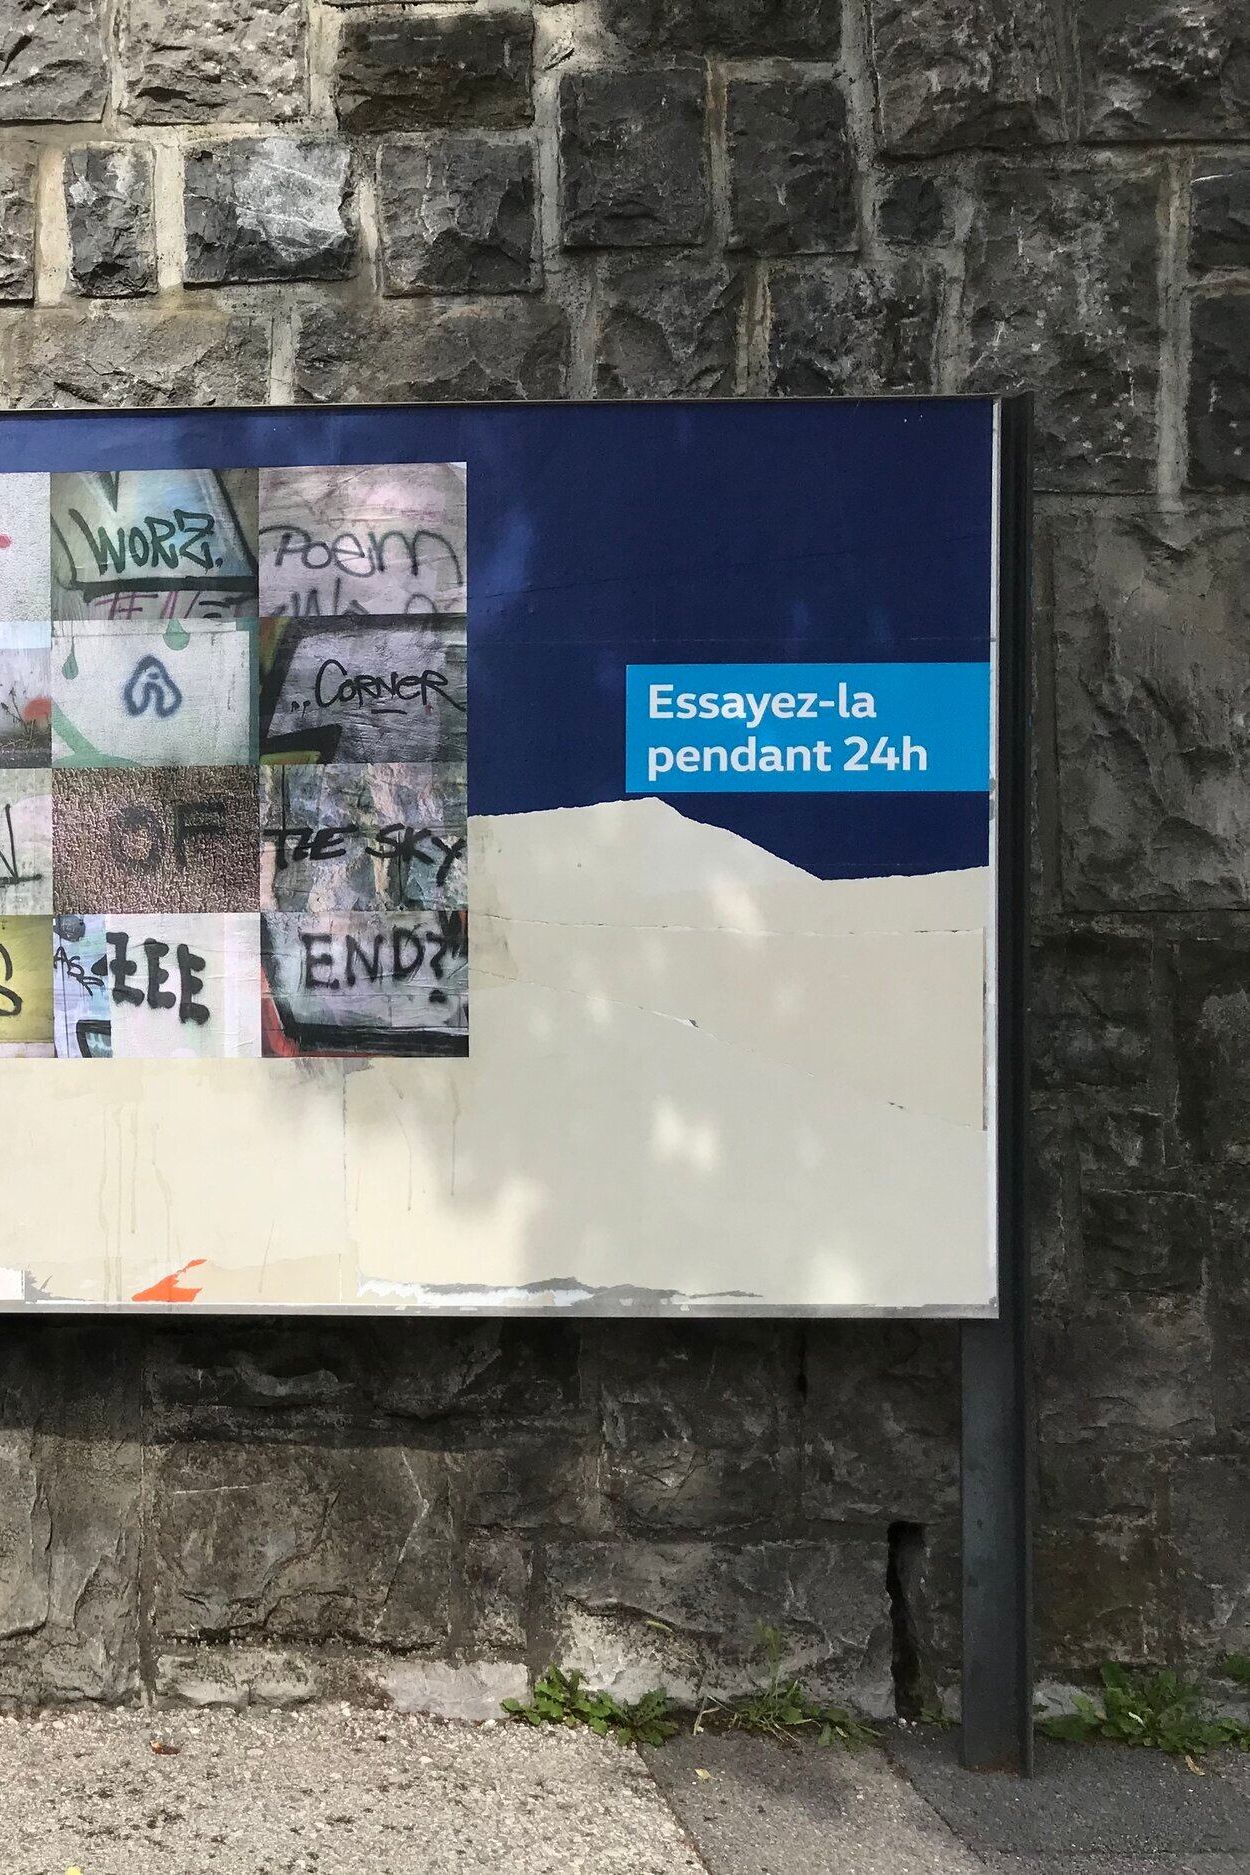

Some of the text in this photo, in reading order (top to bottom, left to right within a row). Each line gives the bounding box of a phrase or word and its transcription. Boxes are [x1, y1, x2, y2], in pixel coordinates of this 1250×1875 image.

[649, 682, 877, 728] Essayez-la
[648, 736, 928, 782] pendant 24h
[364, 822, 466, 887] SKY
